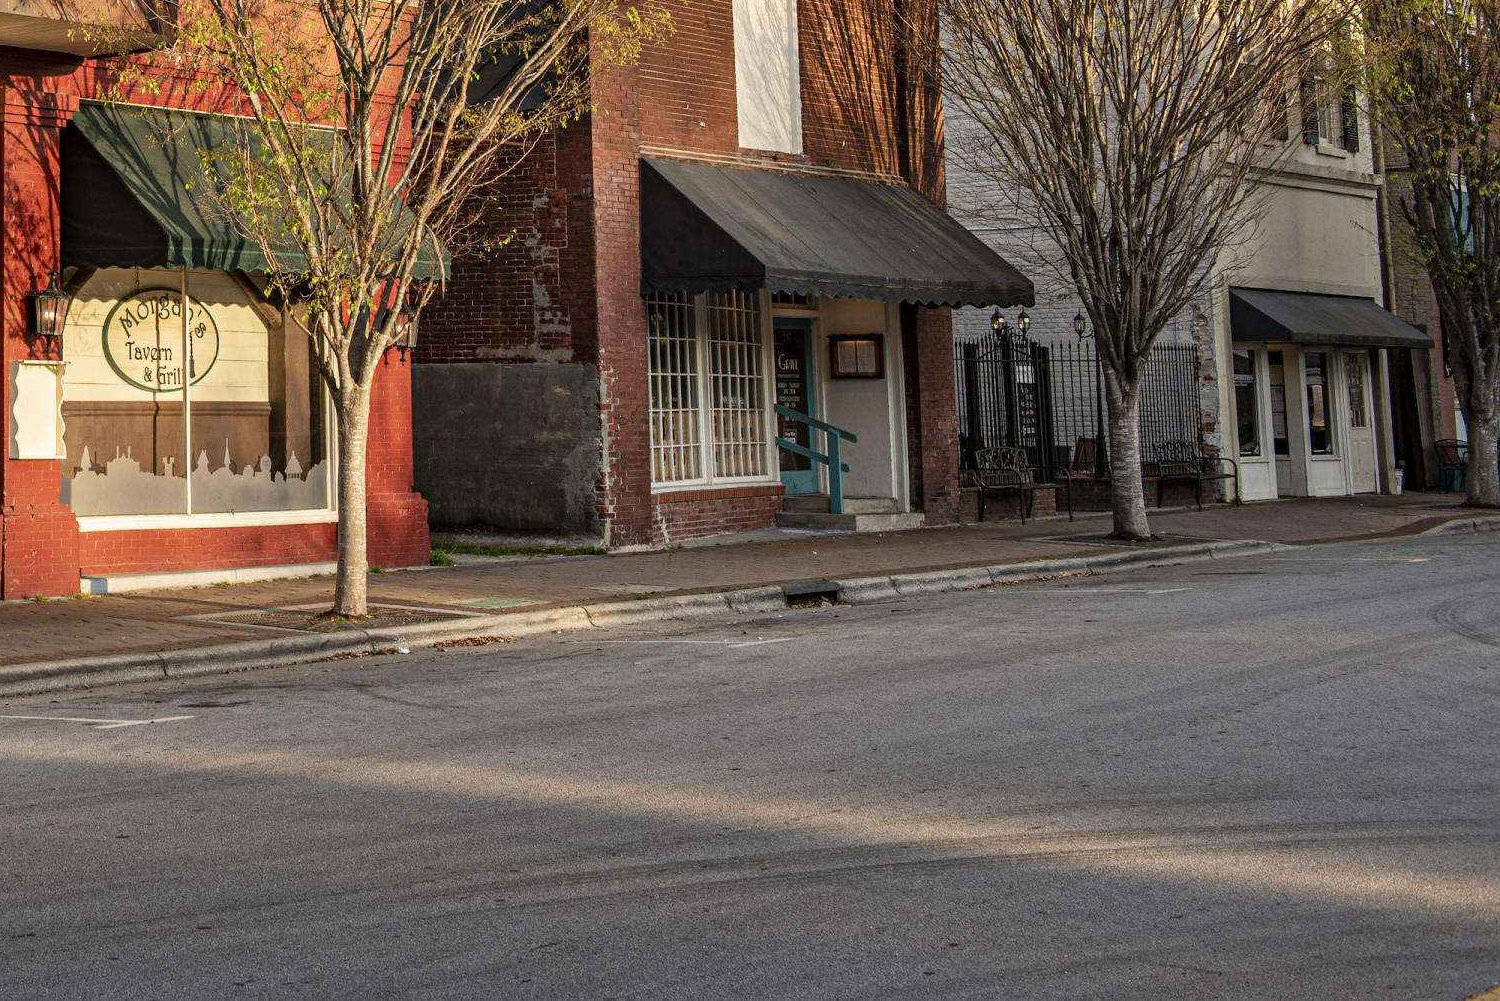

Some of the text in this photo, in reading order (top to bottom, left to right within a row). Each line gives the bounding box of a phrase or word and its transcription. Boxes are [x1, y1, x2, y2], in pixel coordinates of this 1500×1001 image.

[125, 341, 172, 362] Tavern
[143, 365, 184, 386] & Gril
